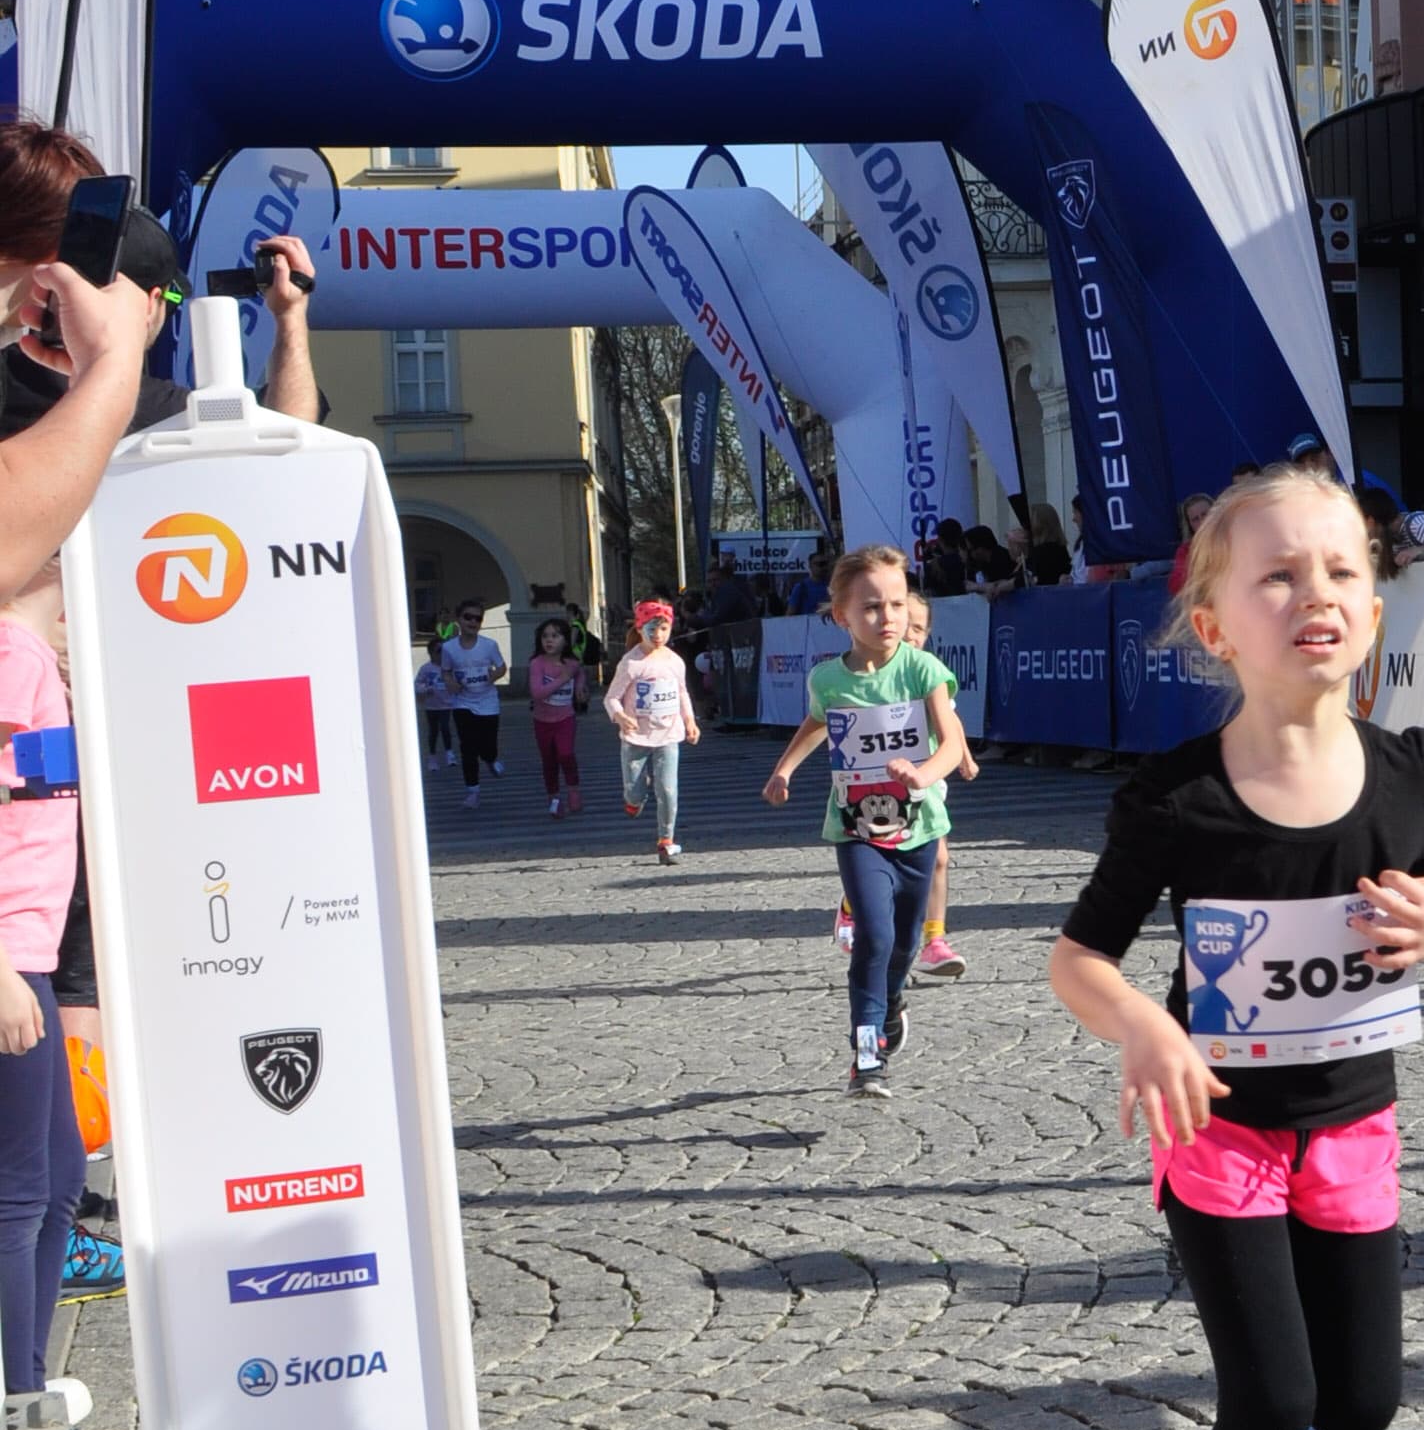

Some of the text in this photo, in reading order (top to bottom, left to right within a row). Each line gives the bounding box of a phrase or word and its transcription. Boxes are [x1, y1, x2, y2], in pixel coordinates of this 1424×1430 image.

[339, 226, 629, 270] INTERSPO
[1072, 245, 1133, 531] PEUGEOT
[267, 539, 347, 579] NN
[735, 557, 808, 571] hitchcock
[750, 545, 789, 558] lekce
[1016, 648, 1106, 680] PEUGEOT
[1386, 652, 1415, 688] NN
[859, 728, 919, 753] 3135
[208, 763, 304, 793] AVON
[304, 894, 360, 910] Powered
[305, 907, 360, 925] by MVM
[1196, 922, 1237, 937] KIDS
[1198, 940, 1233, 955] CUP
[182, 955, 264, 977] innogy
[247, 1034, 315, 1048] PEUGEOT
[233, 1172, 358, 1205] NUTREND
[285, 1350, 388, 1388] ŠKODA
